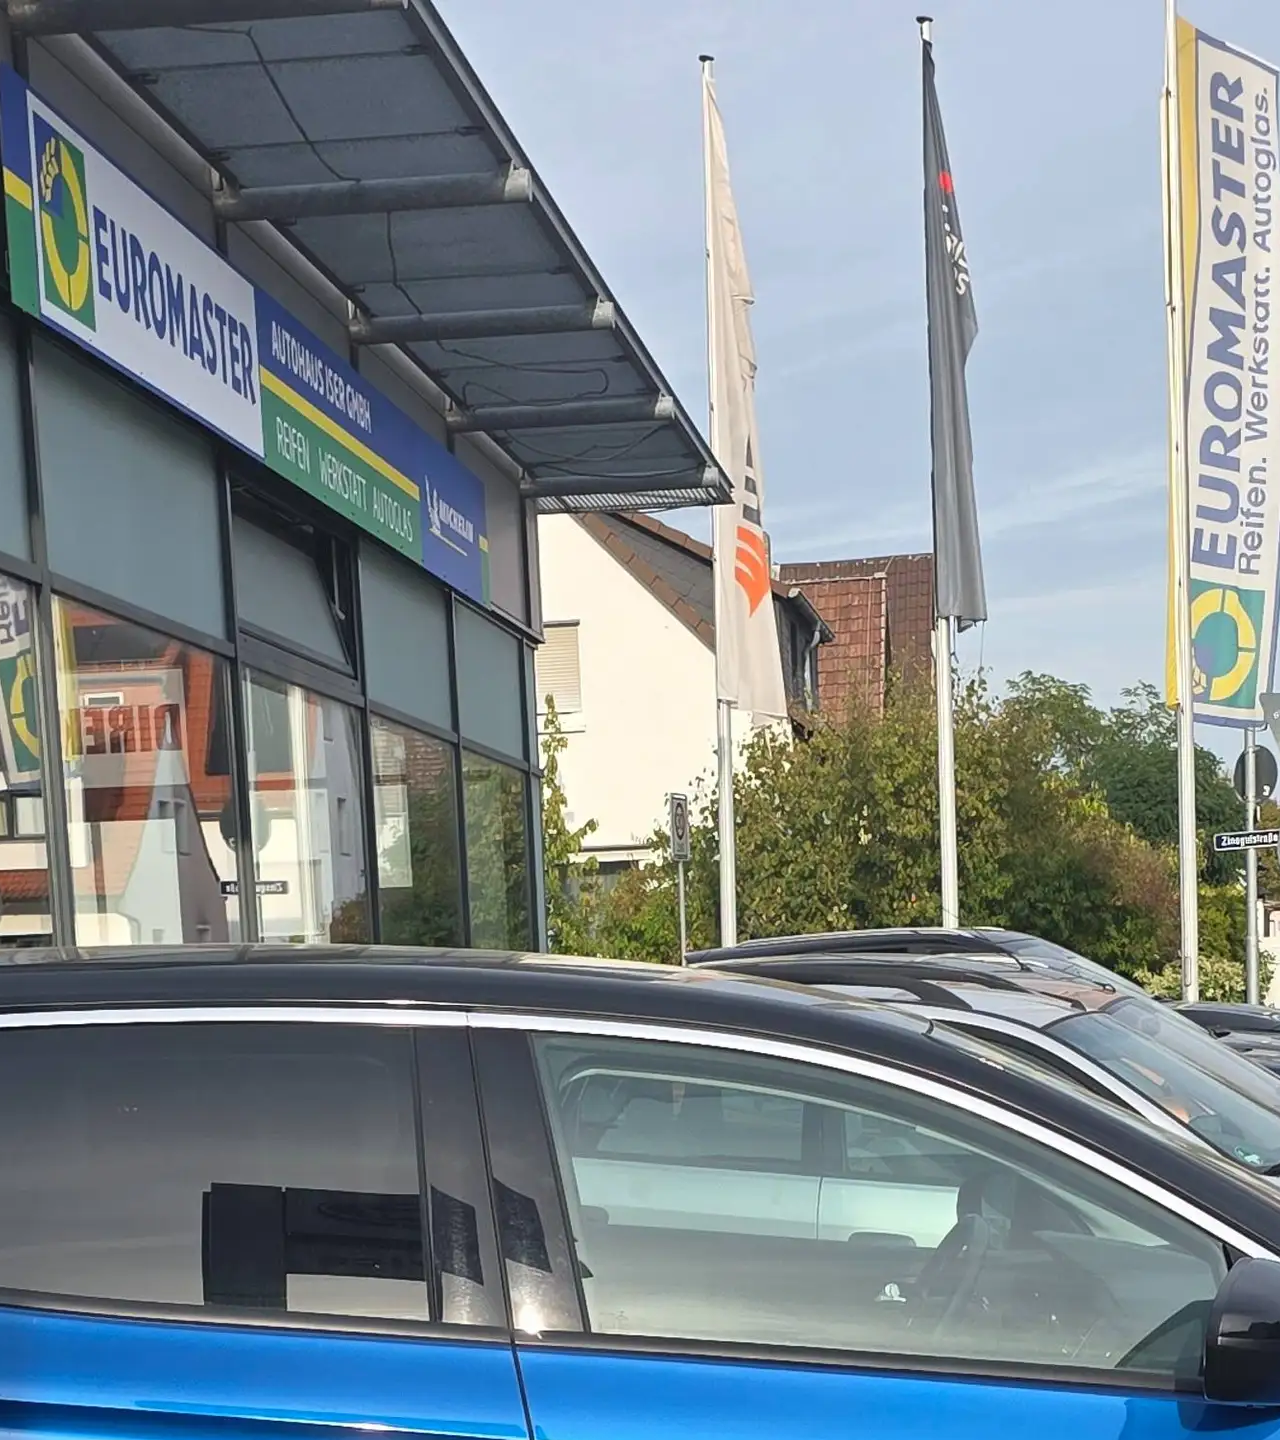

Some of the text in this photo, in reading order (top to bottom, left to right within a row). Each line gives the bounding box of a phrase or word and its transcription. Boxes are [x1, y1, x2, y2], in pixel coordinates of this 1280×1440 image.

[93, 204, 257, 405] EUROMASTER
[271, 320, 324, 396] AUTOHAUS
[1191, 71, 1247, 570] EUROMASTER
[1238, 87, 1276, 575] Reifen. Werkstatt. Autoglas.
[276, 416, 413, 542] REIFEN WERKSTATT AUTOGLAS
